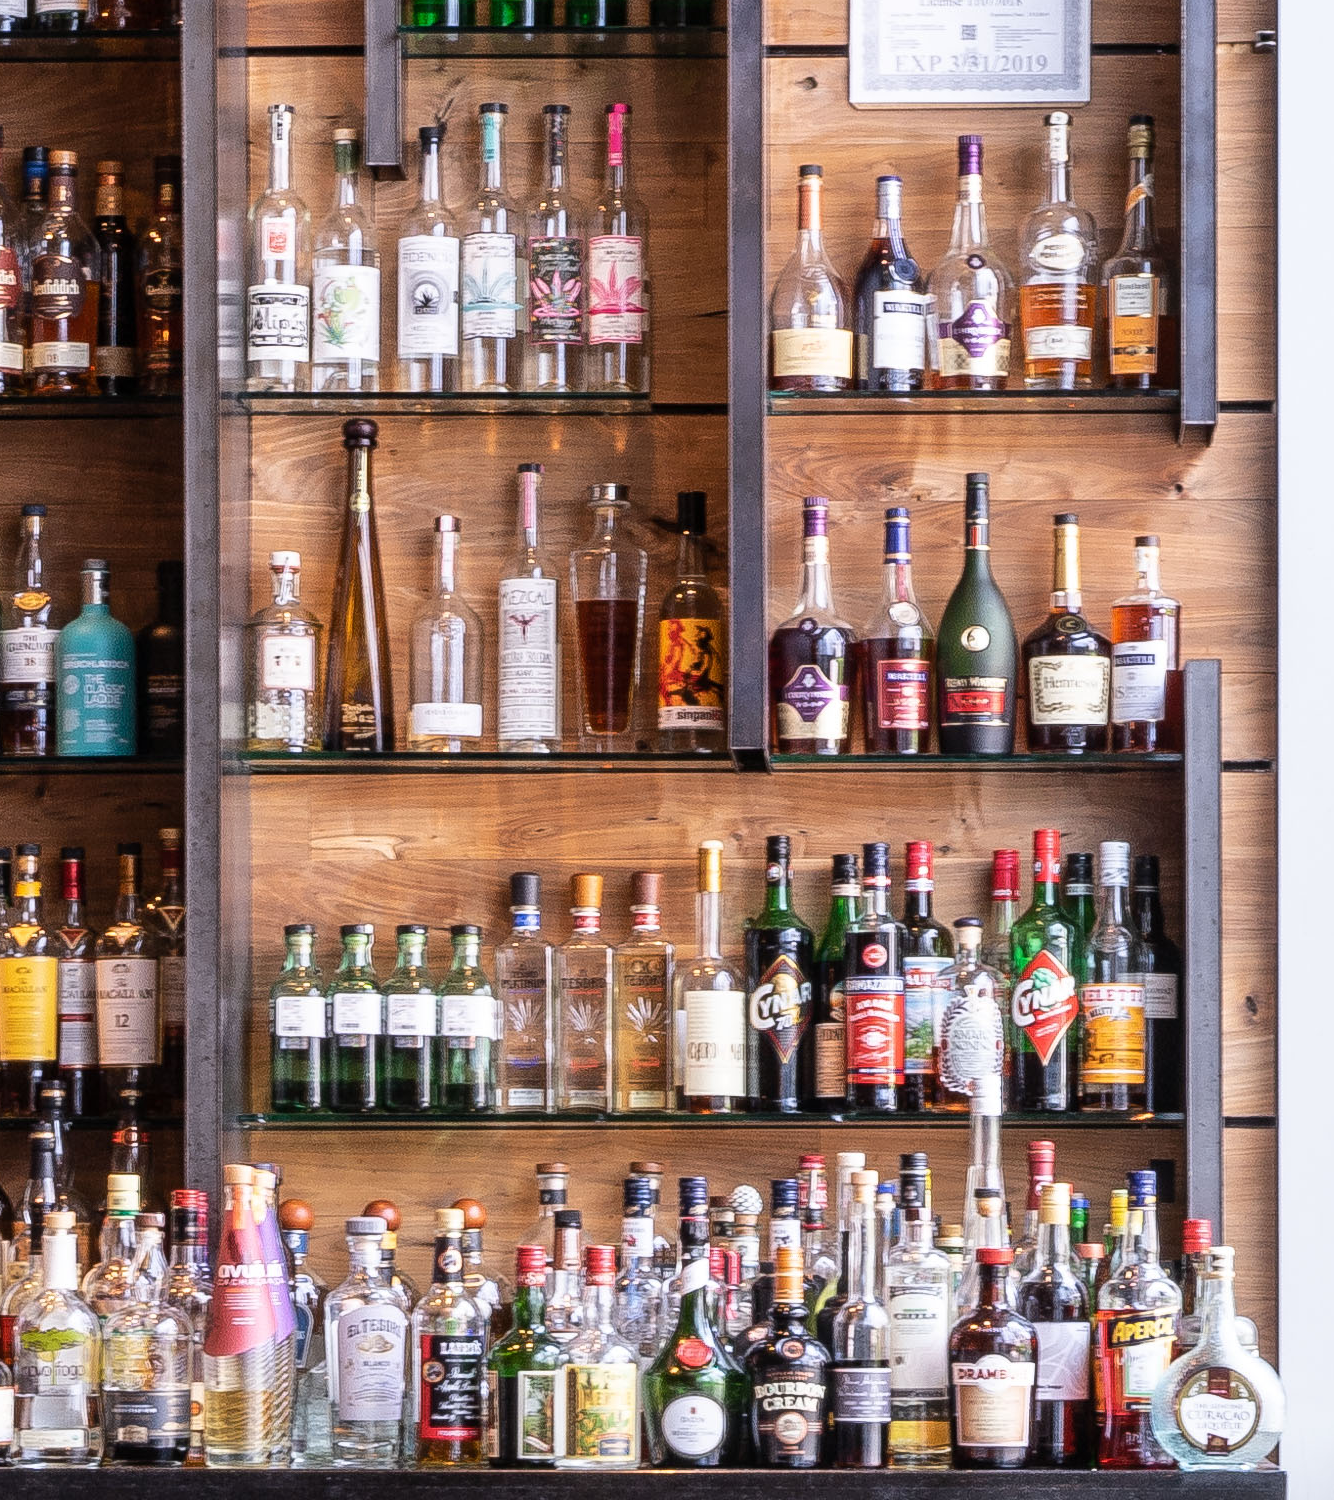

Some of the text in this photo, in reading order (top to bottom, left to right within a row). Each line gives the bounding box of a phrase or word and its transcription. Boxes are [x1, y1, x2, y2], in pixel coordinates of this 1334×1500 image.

[896, 54, 1049, 73] EXP 3/31/2019
[84, 673, 105, 684] THE
[750, 982, 812, 1030] CYNAR
[1012, 975, 1075, 1027] CYNAR
[115, 1014, 129, 1028] 12
[1112, 1317, 1175, 1344] APEROL
[754, 1381, 827, 1399] BOURBON
[762, 1396, 819, 1412] CREAM
